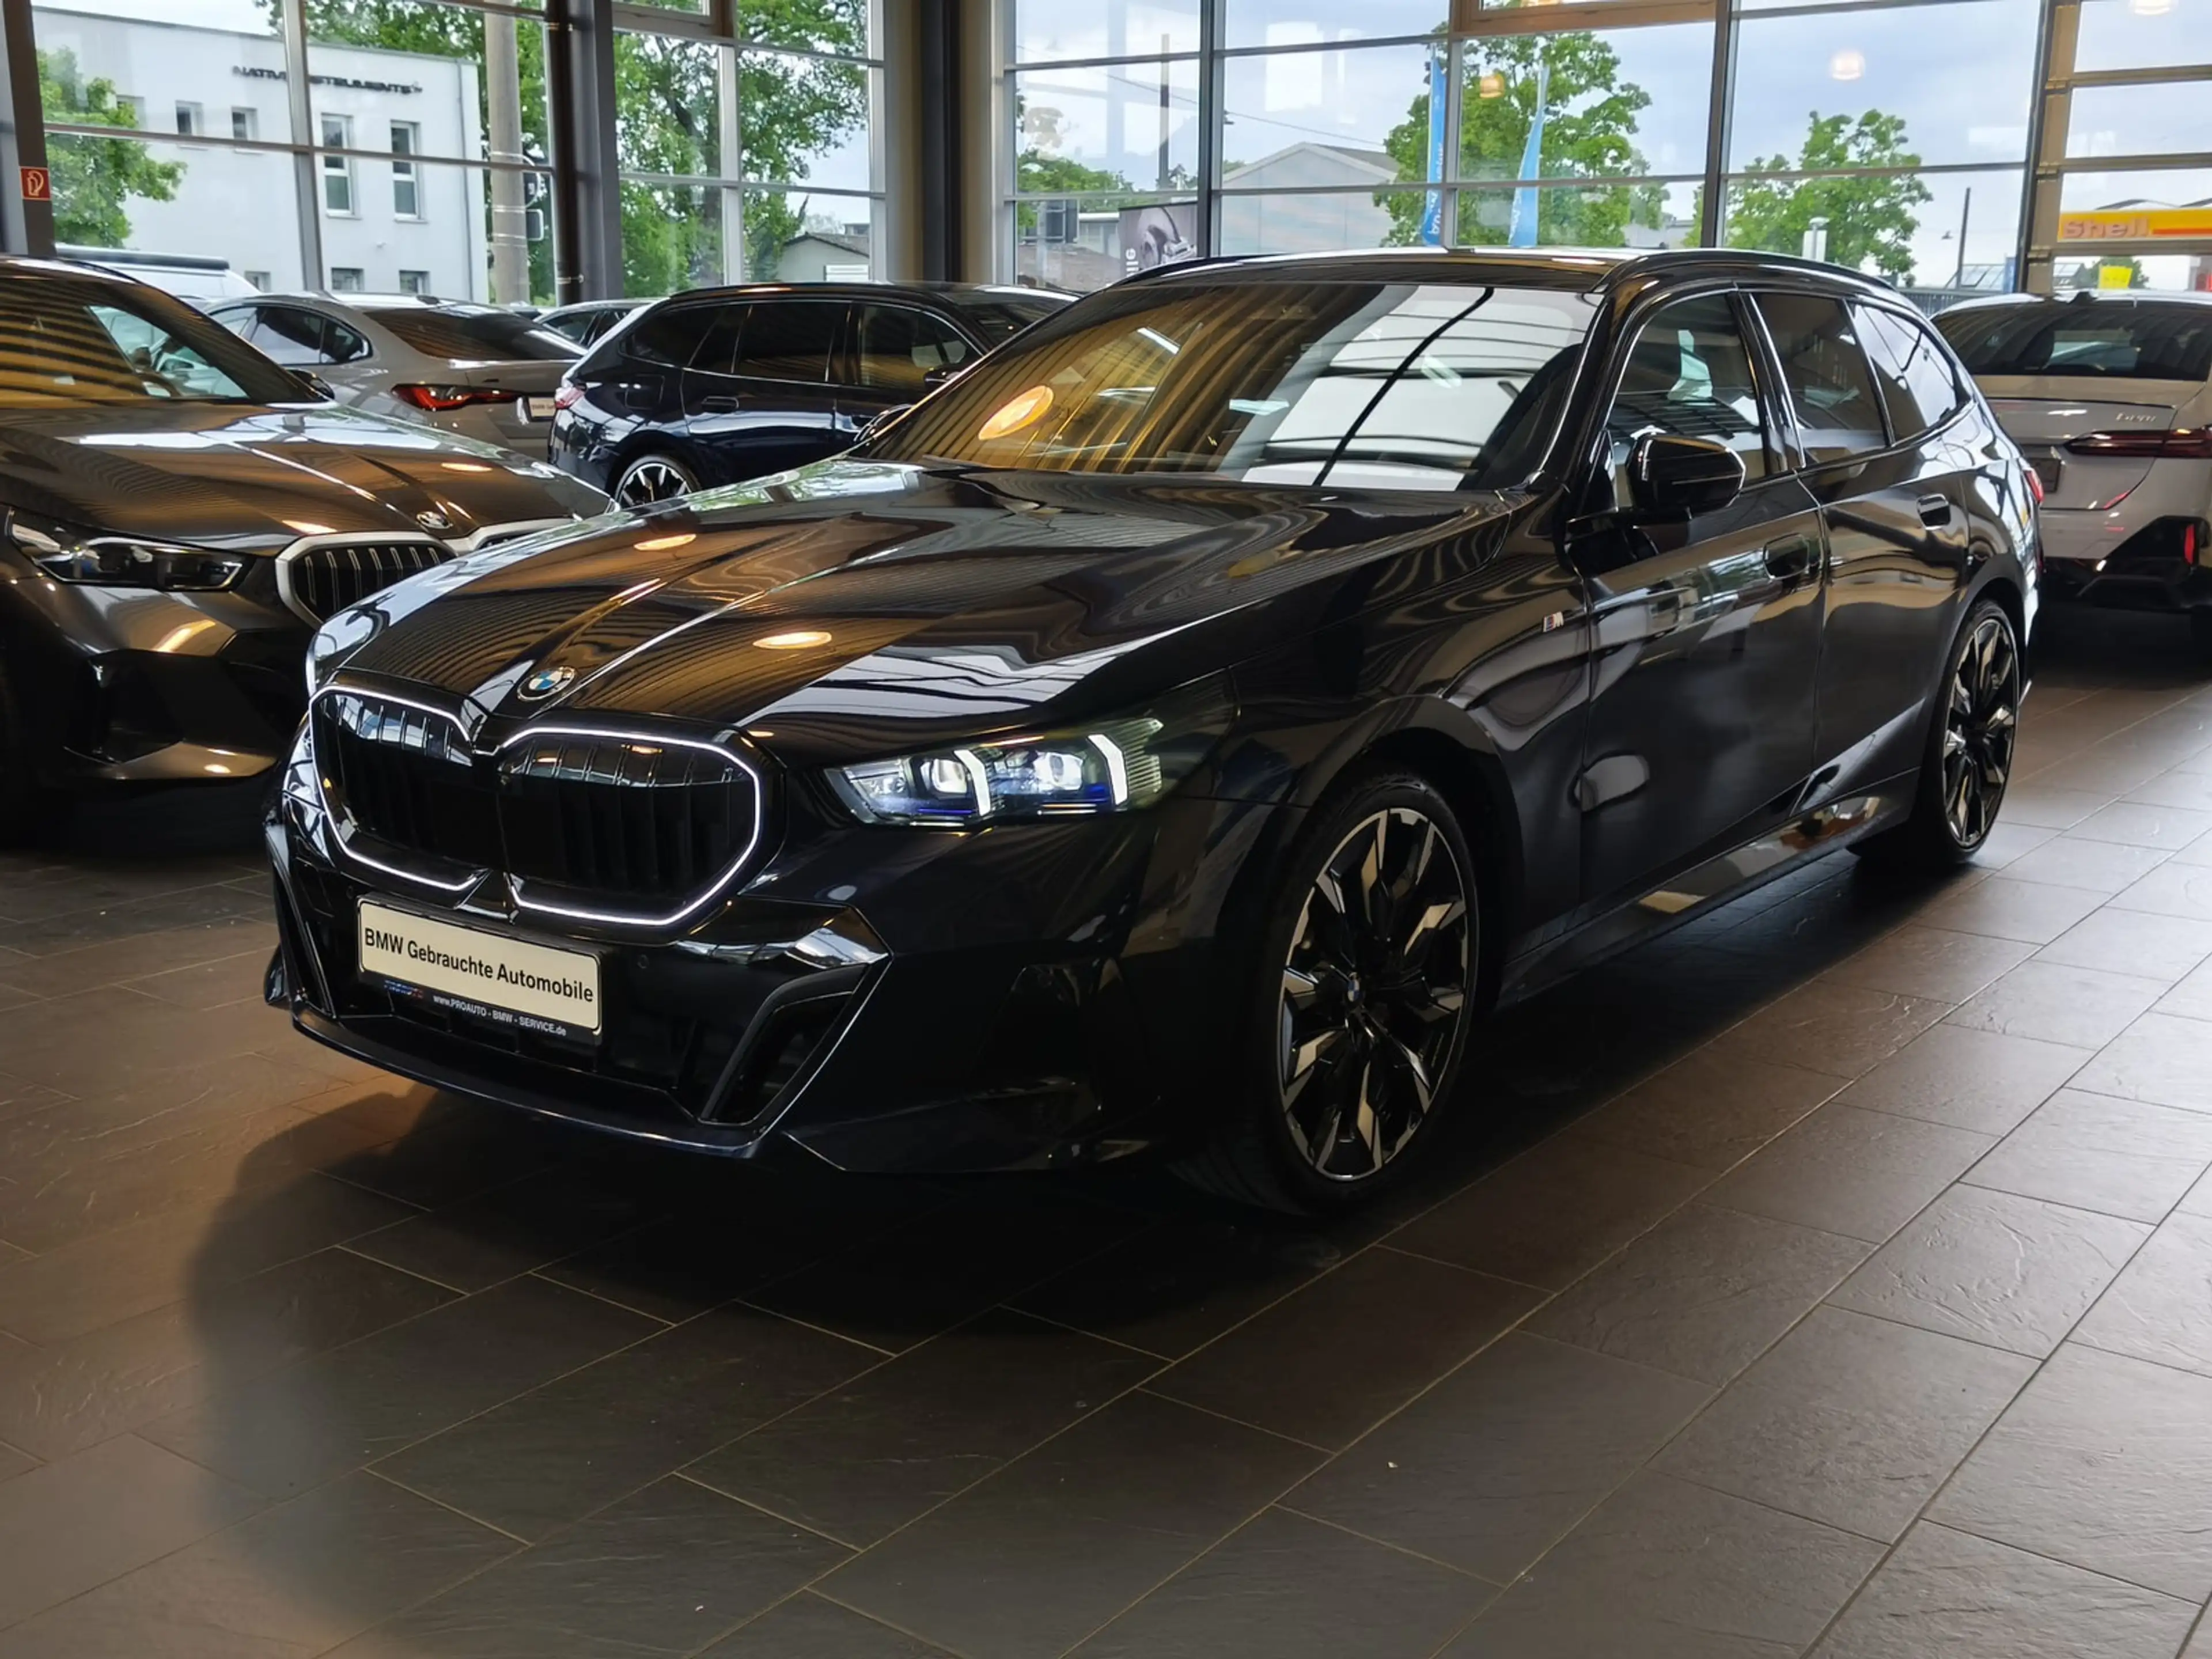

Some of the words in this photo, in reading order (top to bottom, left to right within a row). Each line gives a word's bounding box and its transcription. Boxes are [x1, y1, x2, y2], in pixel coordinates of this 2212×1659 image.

[2062, 218, 2150, 239] Shell
[365, 927, 404, 955] BMW
[407, 940, 494, 979] Gebrauchte
[497, 963, 593, 1002] Automobile
[433, 995, 487, 1017] www.PROAUTO
[493, 1010, 513, 1023] BMW
[519, 1016, 567, 1036] SERVICE.de
